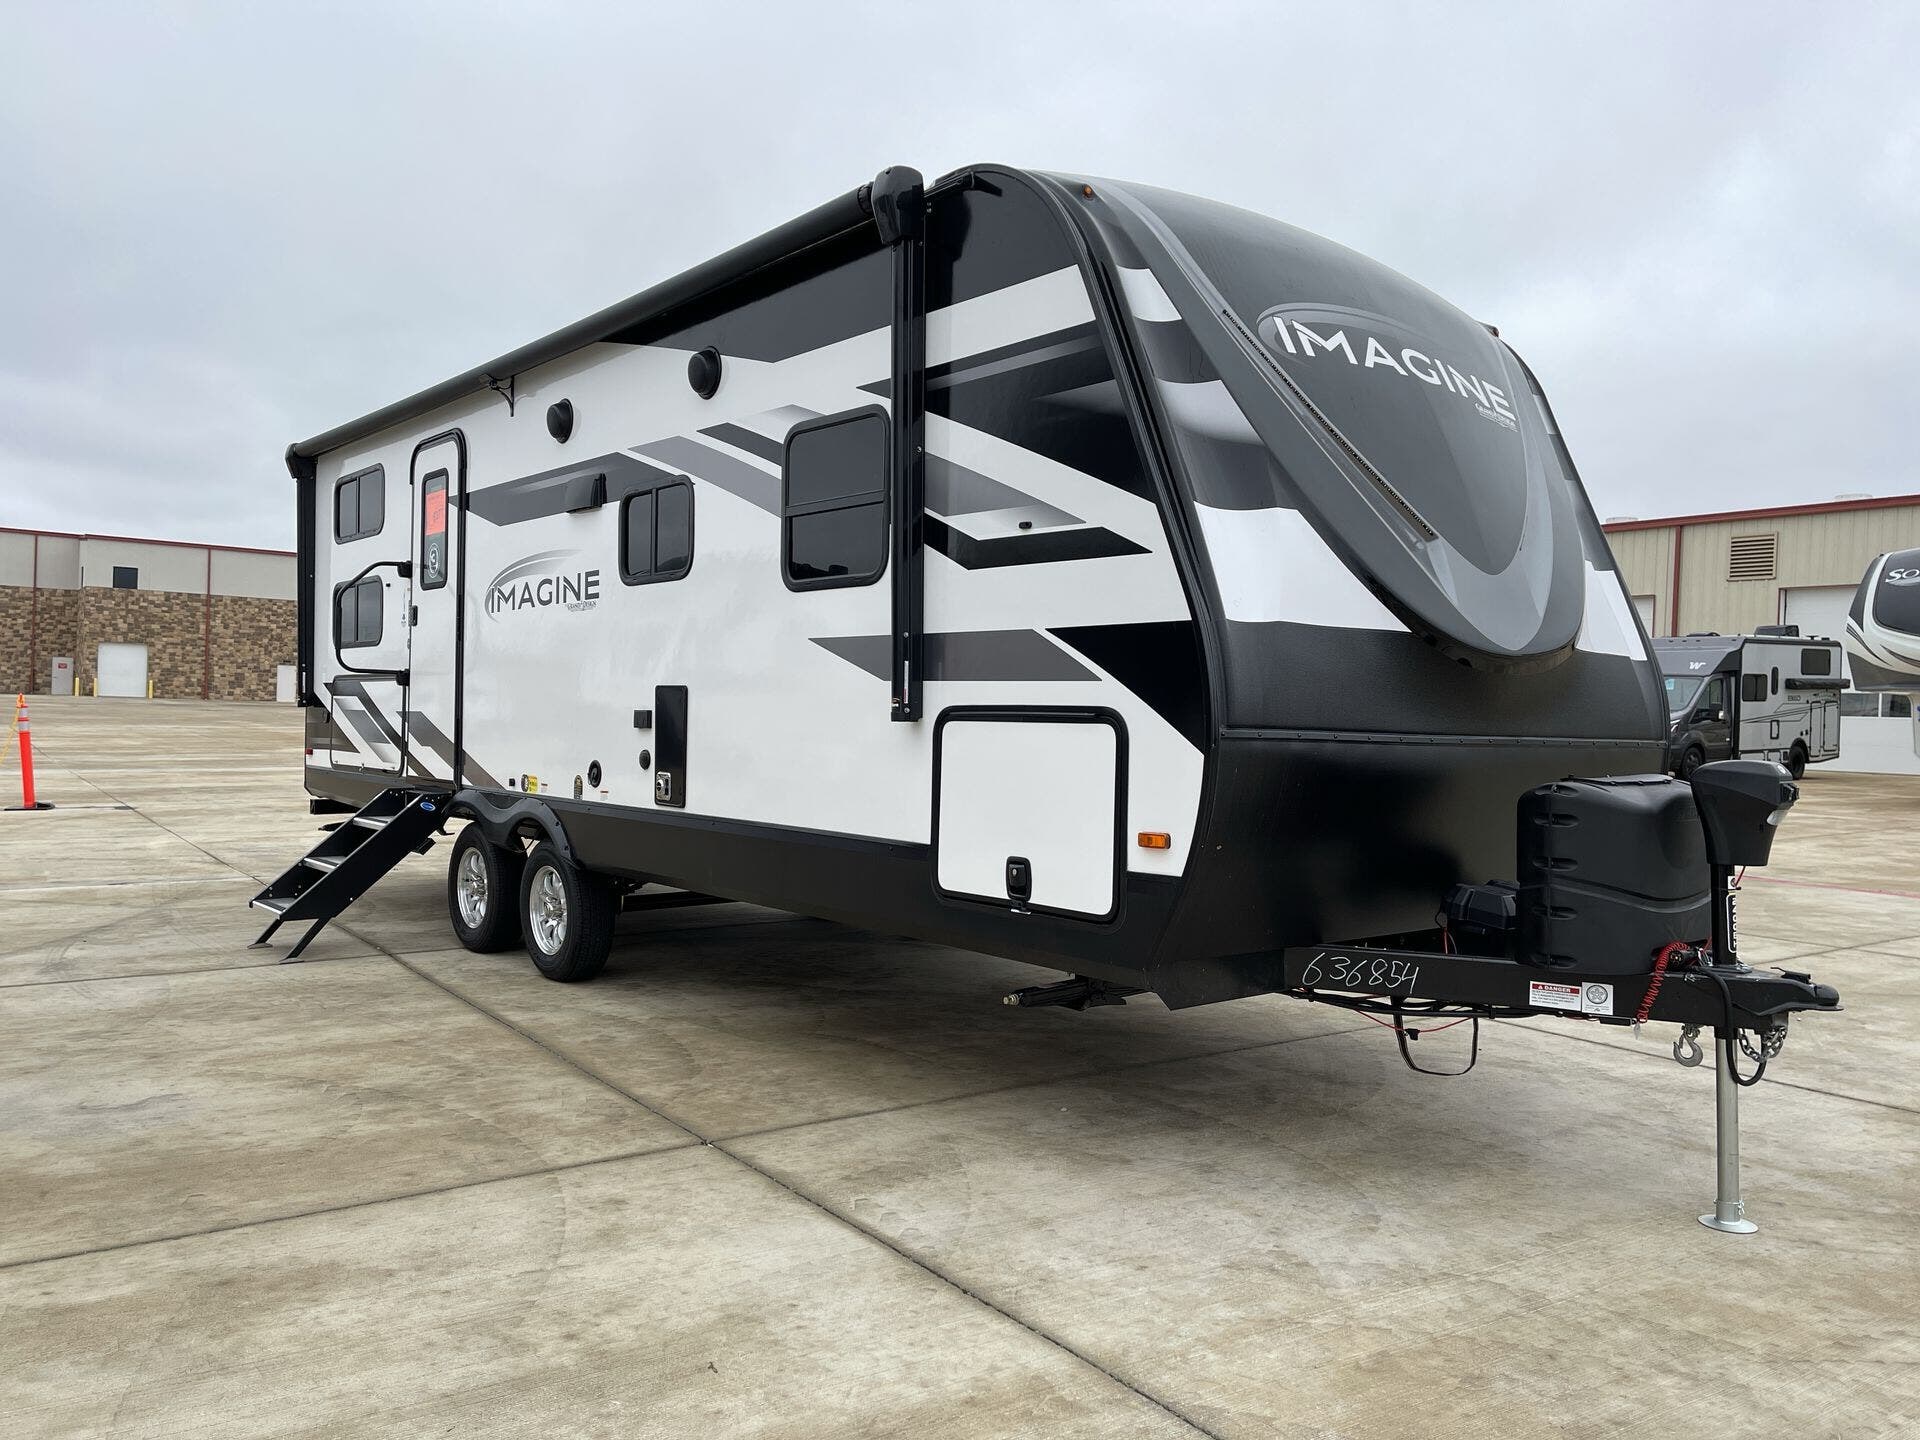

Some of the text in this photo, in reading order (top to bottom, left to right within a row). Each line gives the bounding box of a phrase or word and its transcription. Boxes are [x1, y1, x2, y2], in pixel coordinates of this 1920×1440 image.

[1273, 316, 1516, 422] IMAGINE
[491, 570, 600, 614] IMAGINE
[1302, 953, 1419, 994] 636854
[1544, 985, 1571, 993] DANGER
